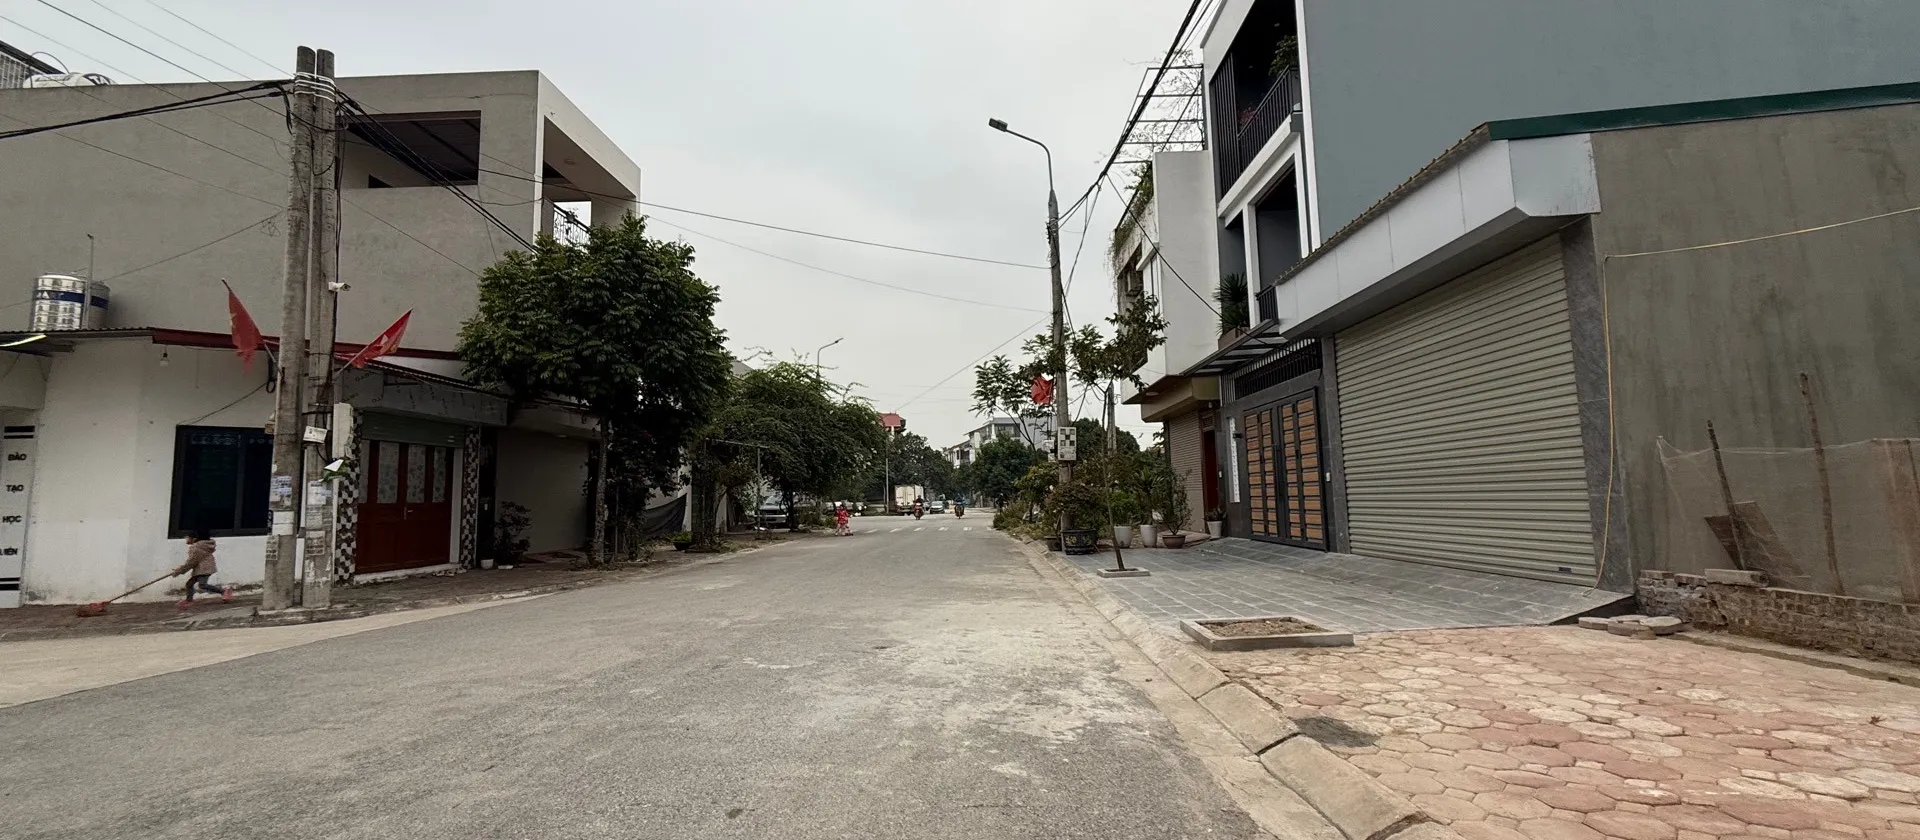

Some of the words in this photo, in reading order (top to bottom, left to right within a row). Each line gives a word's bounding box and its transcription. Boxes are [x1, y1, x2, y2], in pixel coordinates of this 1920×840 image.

[8, 452, 27, 461] ĐÀO
[6, 484, 24, 493] TẠO
[2, 515, 22, 524] HỌC
